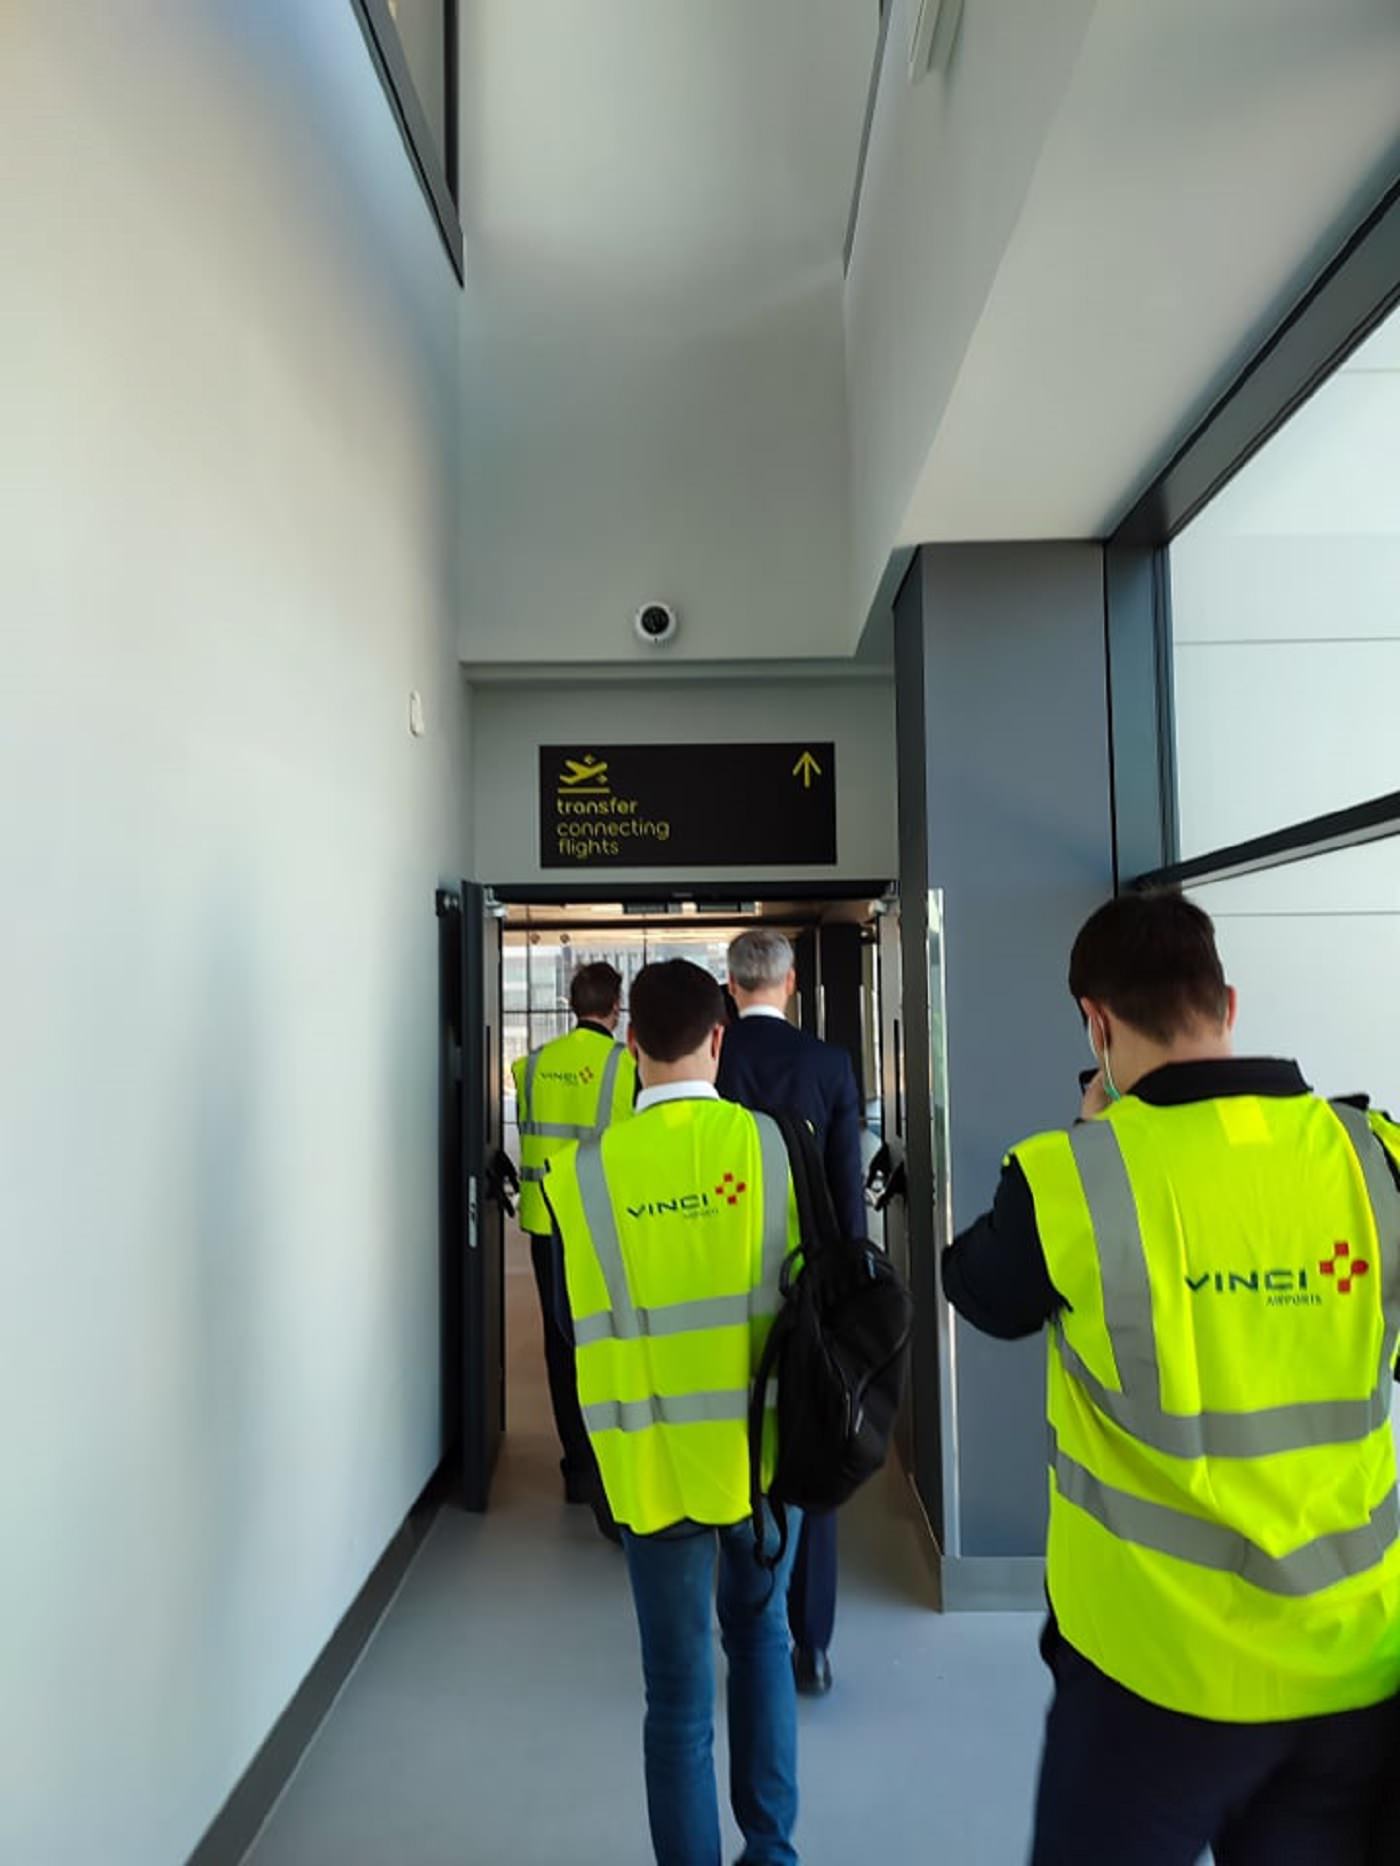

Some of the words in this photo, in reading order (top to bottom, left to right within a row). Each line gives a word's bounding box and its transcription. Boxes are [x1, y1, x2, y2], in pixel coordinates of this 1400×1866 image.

[557, 797, 638, 815] transfer
[557, 820, 670, 841] connecting
[559, 838, 620, 859] flights
[626, 1193, 708, 1218] VINCI
[1185, 1269, 1307, 1292] VINCI
